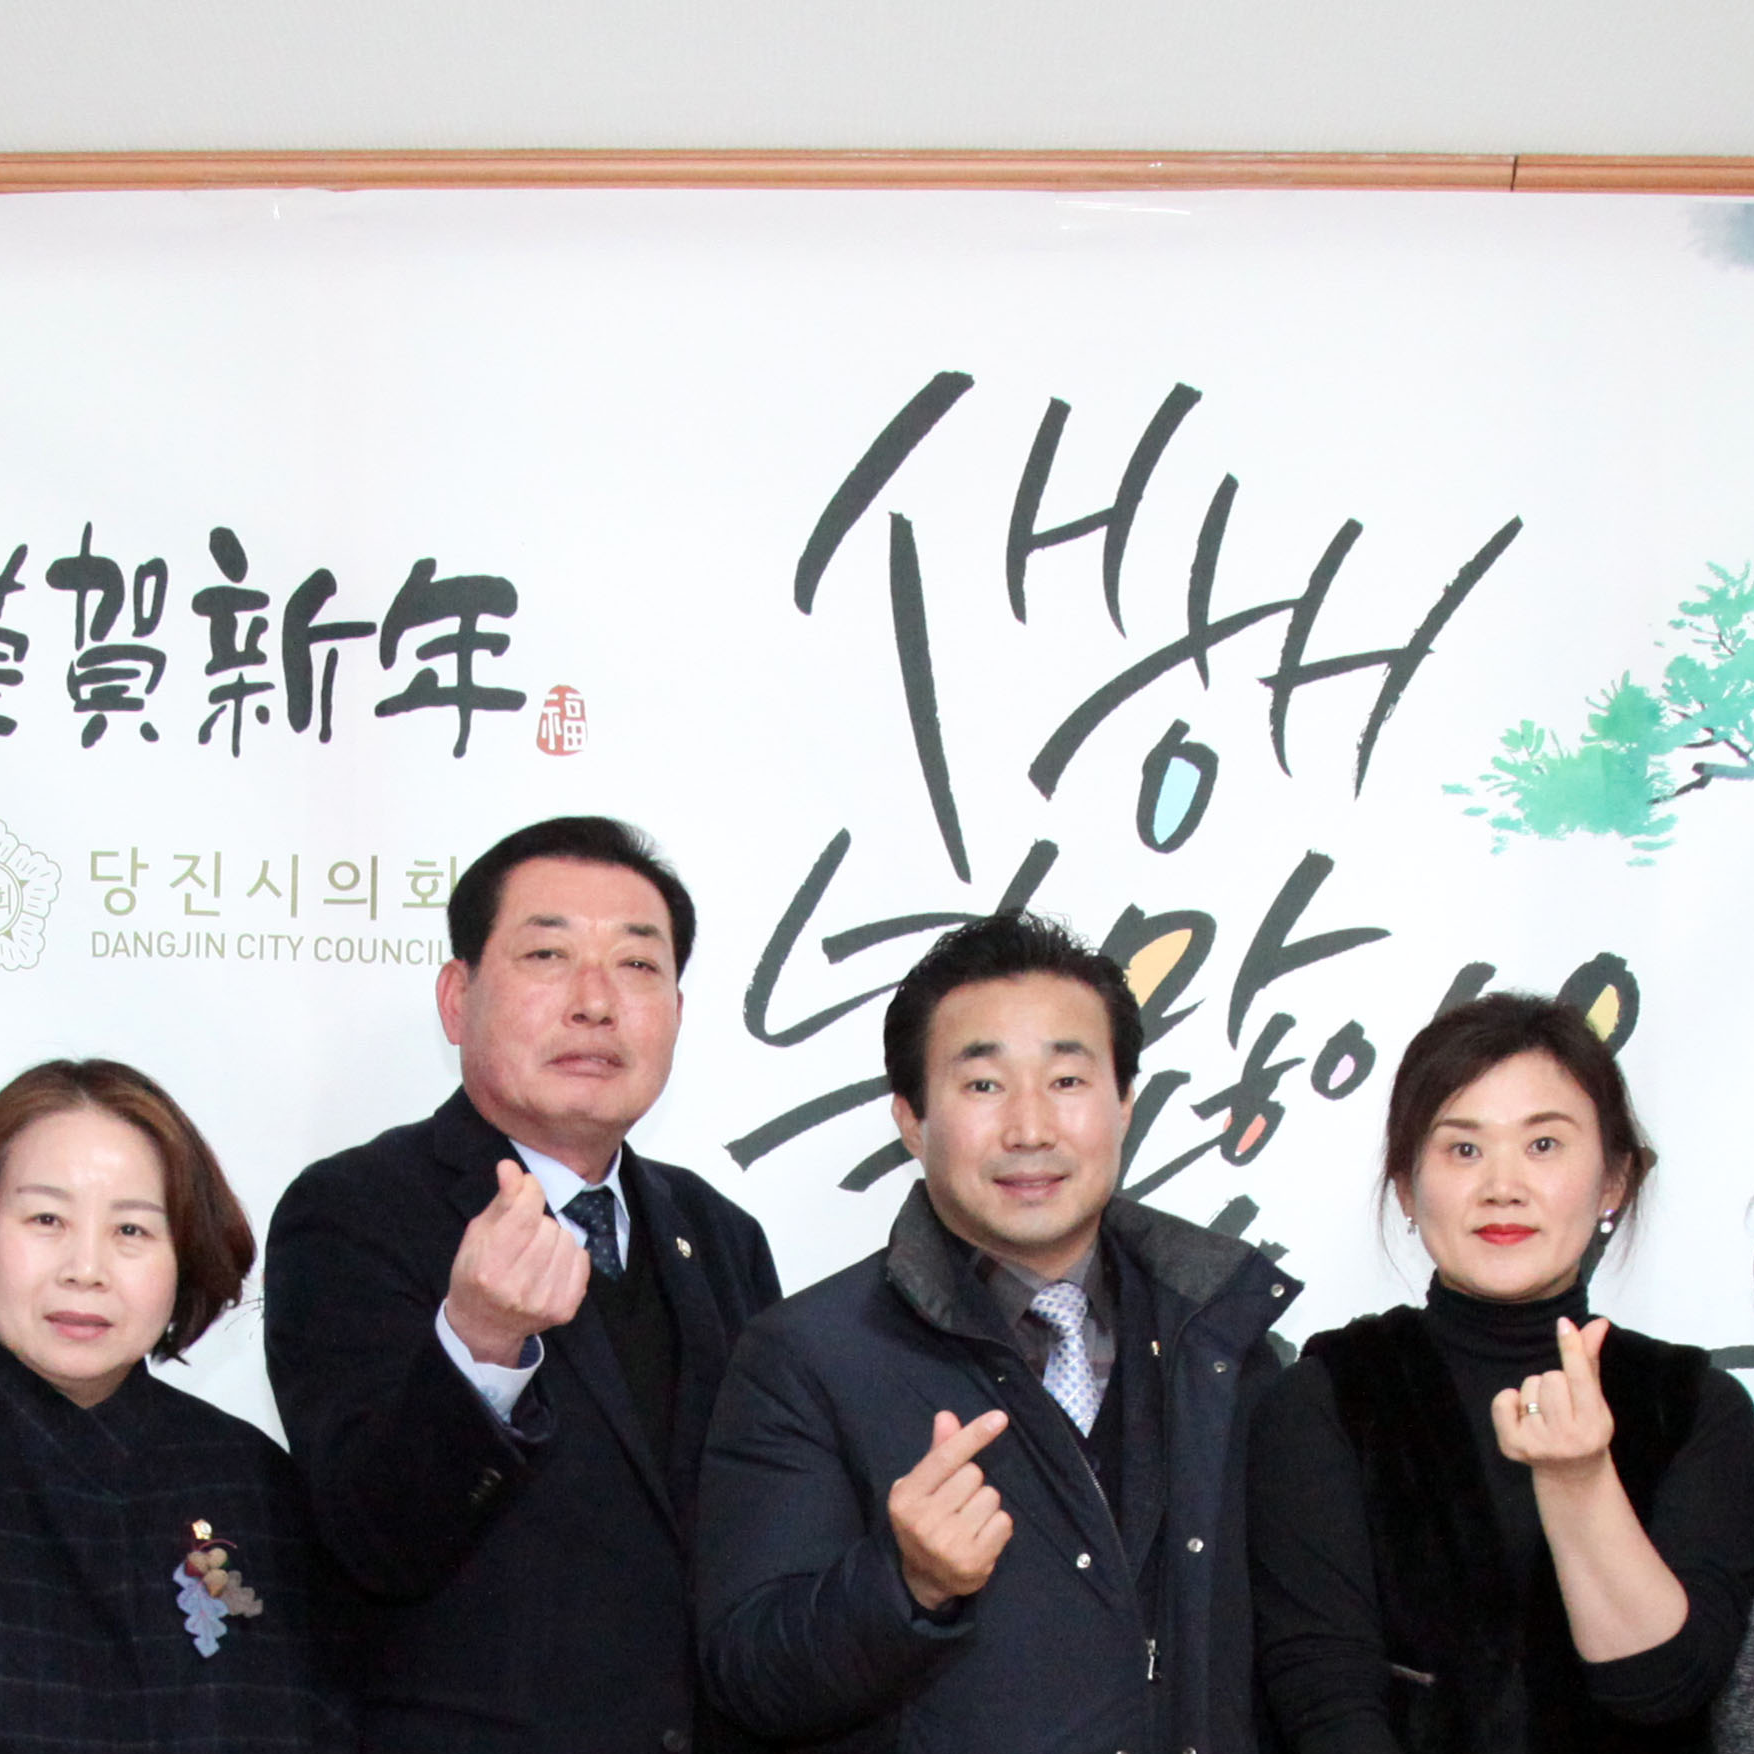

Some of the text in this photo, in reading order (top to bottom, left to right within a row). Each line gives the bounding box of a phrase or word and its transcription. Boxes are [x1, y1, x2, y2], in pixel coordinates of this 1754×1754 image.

[91, 930, 448, 965] DANGJIN CITY COUNCIL
